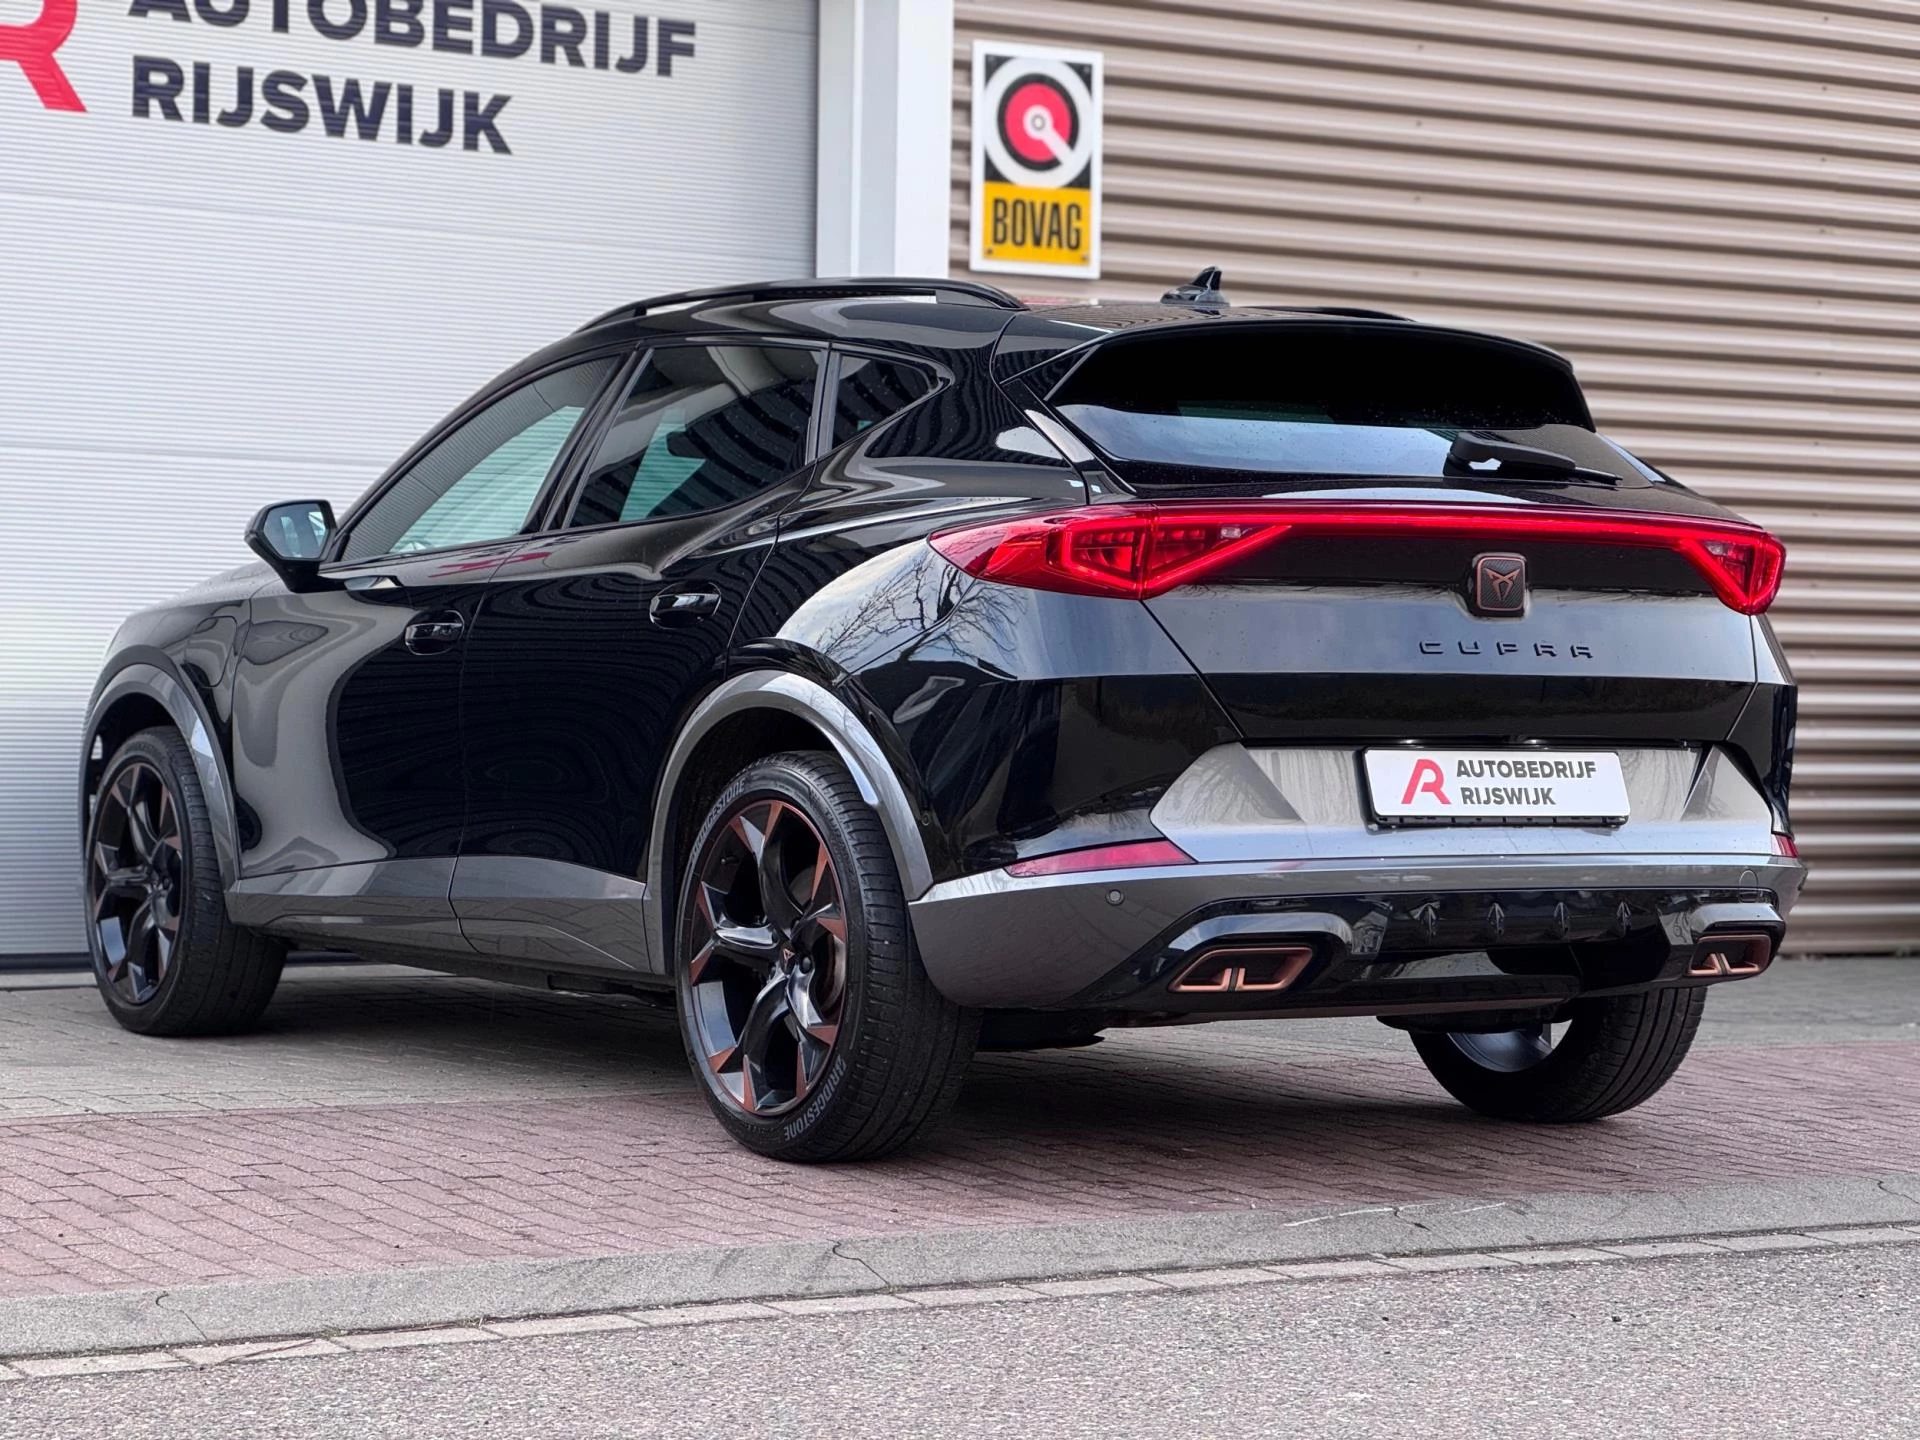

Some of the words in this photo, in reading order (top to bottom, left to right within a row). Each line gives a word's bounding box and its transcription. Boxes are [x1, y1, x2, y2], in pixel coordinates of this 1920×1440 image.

[128, 0, 697, 78] OBEDRIJF
[131, 54, 513, 156] RIJSWIJK
[992, 197, 1082, 251] BOVAG
[1419, 640, 1594, 659] CUPRA
[1456, 759, 1597, 779] AUTOBEDRIJF
[1460, 786, 1557, 806] RIJSWIJK
[783, 1053, 847, 1141] BRIDGESTONE
